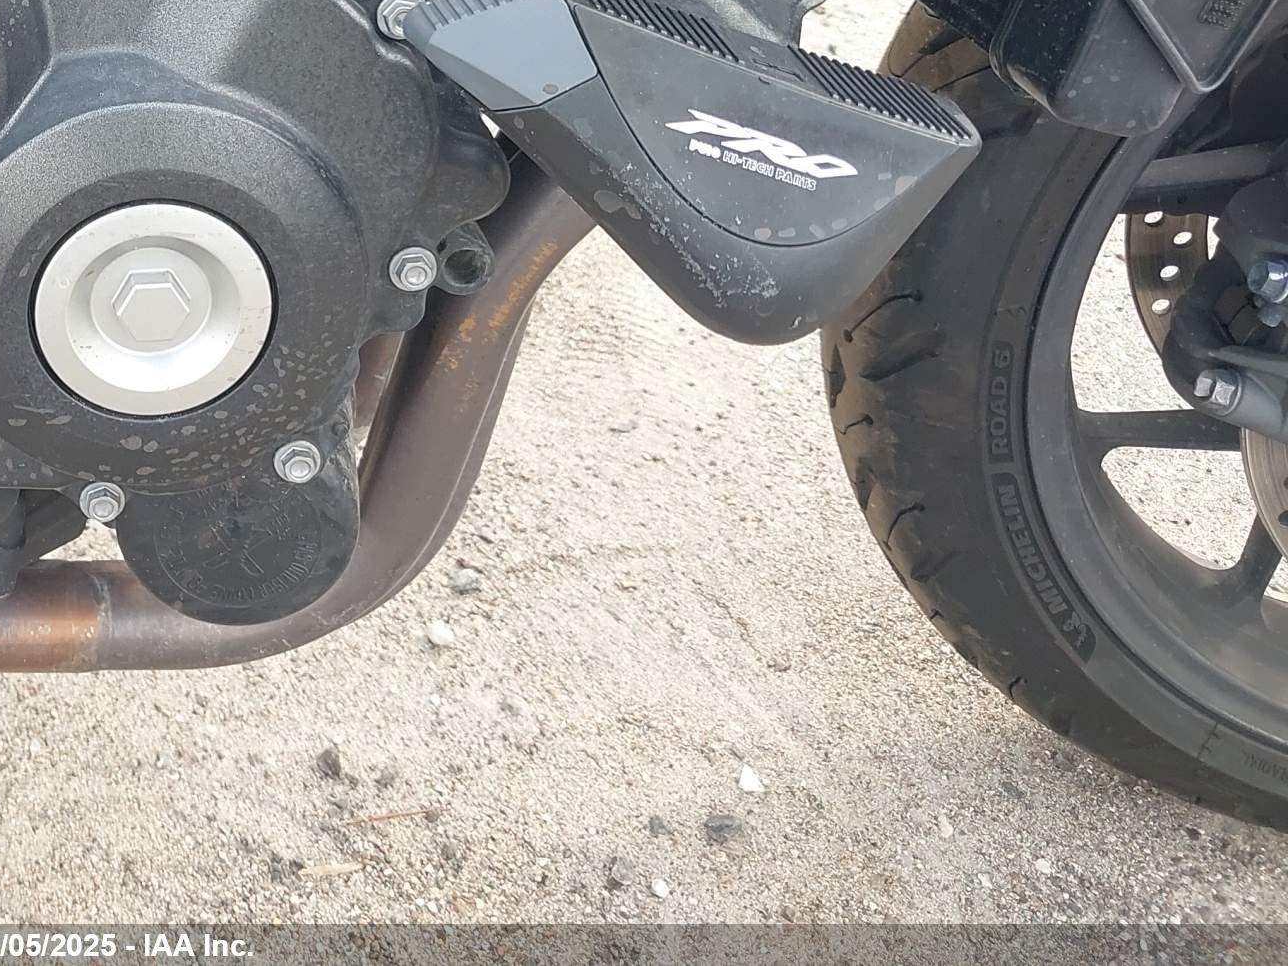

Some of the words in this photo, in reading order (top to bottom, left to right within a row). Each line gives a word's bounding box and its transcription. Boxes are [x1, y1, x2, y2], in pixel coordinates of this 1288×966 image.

[665, 108, 858, 178] PRO
[723, 151, 775, 178] HI-TECH
[775, 167, 817, 191] PARTS
[990, 376, 1009, 456] ROAD
[998, 484, 1068, 616] MICHELIN
